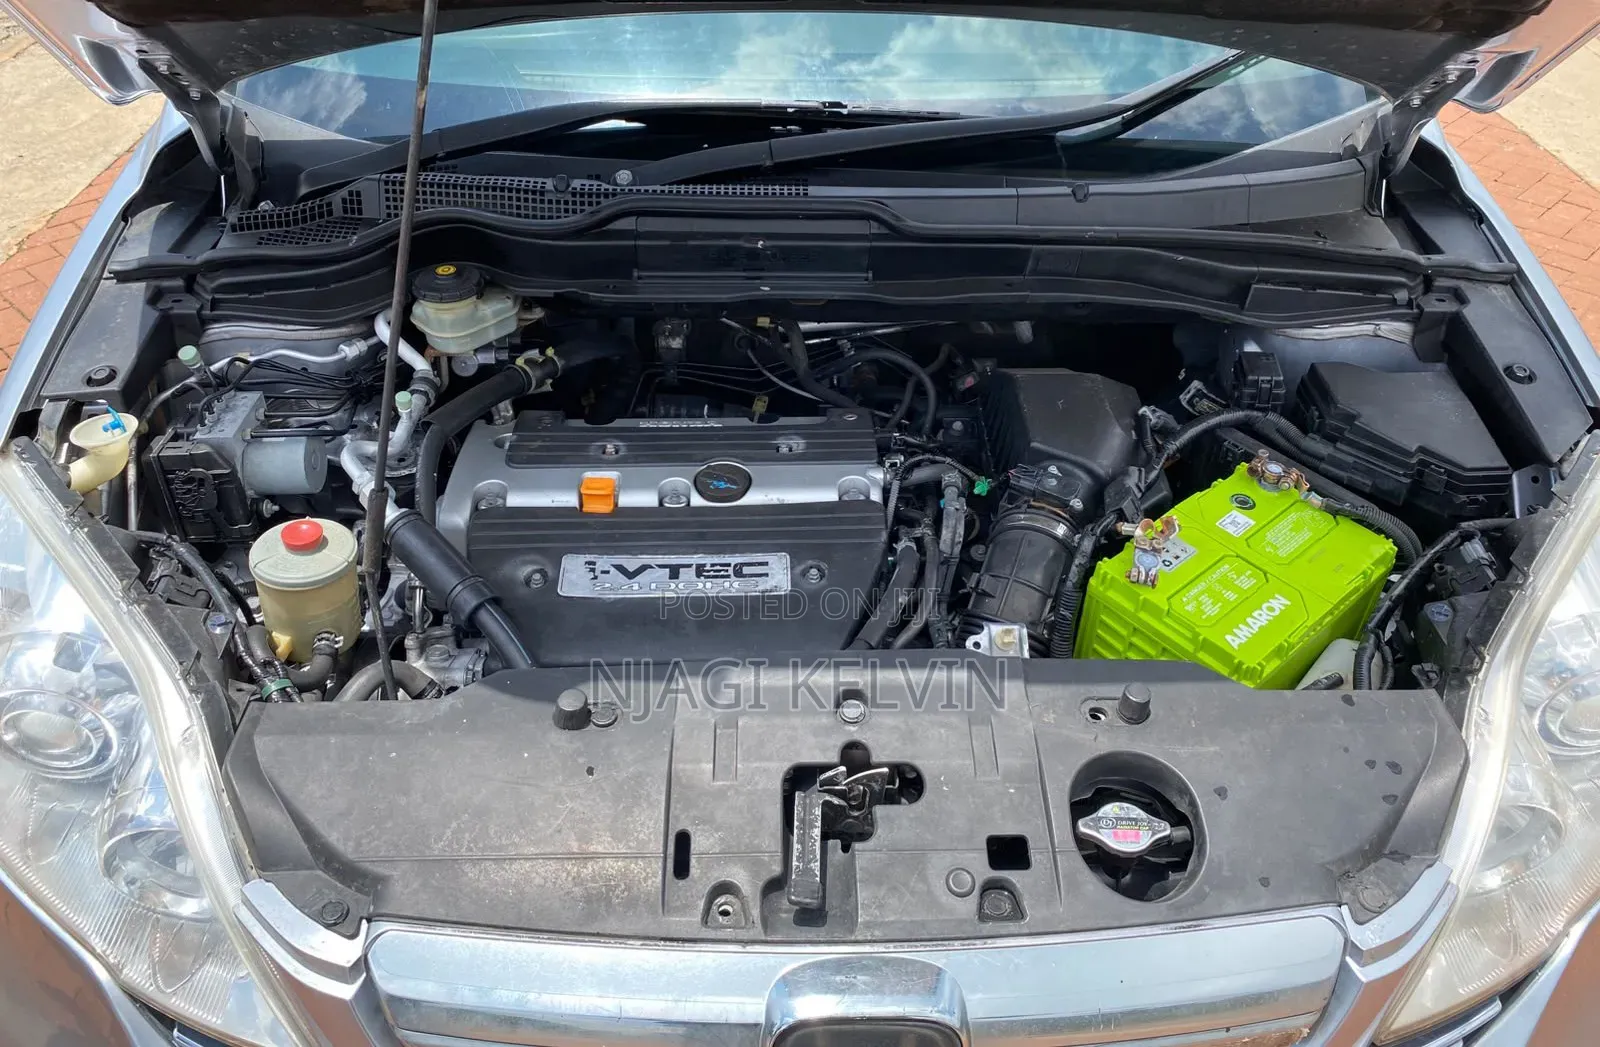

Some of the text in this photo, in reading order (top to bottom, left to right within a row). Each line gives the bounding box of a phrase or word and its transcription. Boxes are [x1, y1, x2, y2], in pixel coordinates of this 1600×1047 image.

[584, 560, 769, 580] i-VTEC
[650, 581, 759, 591] DOHC
[1225, 594, 1291, 650] AMARON
